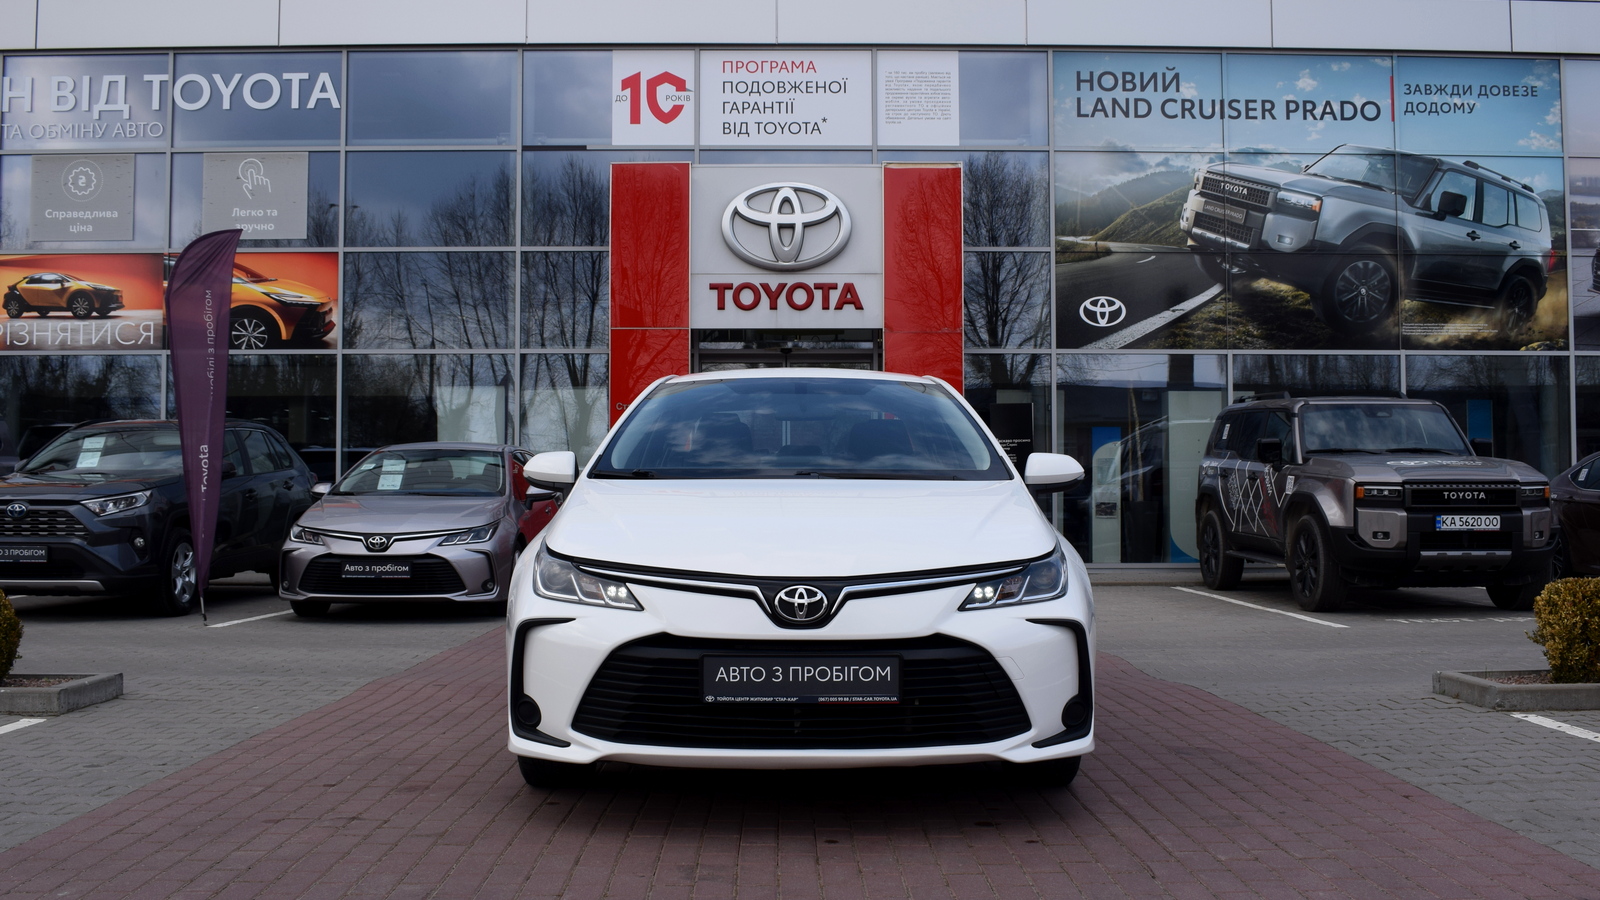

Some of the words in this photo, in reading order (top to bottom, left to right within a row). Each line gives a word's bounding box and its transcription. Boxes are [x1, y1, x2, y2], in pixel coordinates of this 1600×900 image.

[722, 60, 817, 73] ПРОГРАМА
[722, 77, 848, 96] ПОДОВЖЕНОЇ
[1076, 66, 1180, 93] НОВИЙ
[51, 74, 130, 120] ВІД
[143, 72, 341, 111] TOYOTA
[615, 94, 628, 102] ДО
[665, 94, 691, 102] РОКІВ
[1403, 83, 1473, 98] ЗАВЖДИ
[1477, 85, 1538, 99] ДОВЕЗЕ
[722, 98, 796, 114] ГАРАНТІЇ
[1076, 97, 1153, 119] LAND
[1160, 98, 1276, 120] CRUISER
[1285, 99, 1382, 122] PRADO
[1403, 101, 1476, 116] ДОДОМУ
[1, 123, 23, 139] ТА
[28, 122, 108, 139] ОБМІНУ
[112, 121, 164, 138] АВТО
[722, 121, 750, 137] ВІД
[1220, 182, 1248, 195] TOYOTA
[45, 208, 118, 220] Справедлива
[232, 207, 263, 217] Легко
[266, 209, 278, 217] та
[69, 222, 93, 234] ціна
[235, 221, 275, 232] зручно
[709, 281, 864, 311] TOYOTA
[203, 289, 216, 345] пробігом
[0, 321, 154, 346] ІЗНЯТИСЯ
[1443, 491, 1486, 500] TOYOTA
[1441, 516, 1456, 527] KA
[1459, 516, 1482, 527] 5620
[9, 548, 45, 556] ПРОБІГОМ
[344, 563, 364, 572] Авто
[371, 563, 409, 573] пробігом
[715, 666, 766, 682] АВТО
[771, 666, 783, 682] З
[789, 666, 891, 682] ПРОБІГОМ
